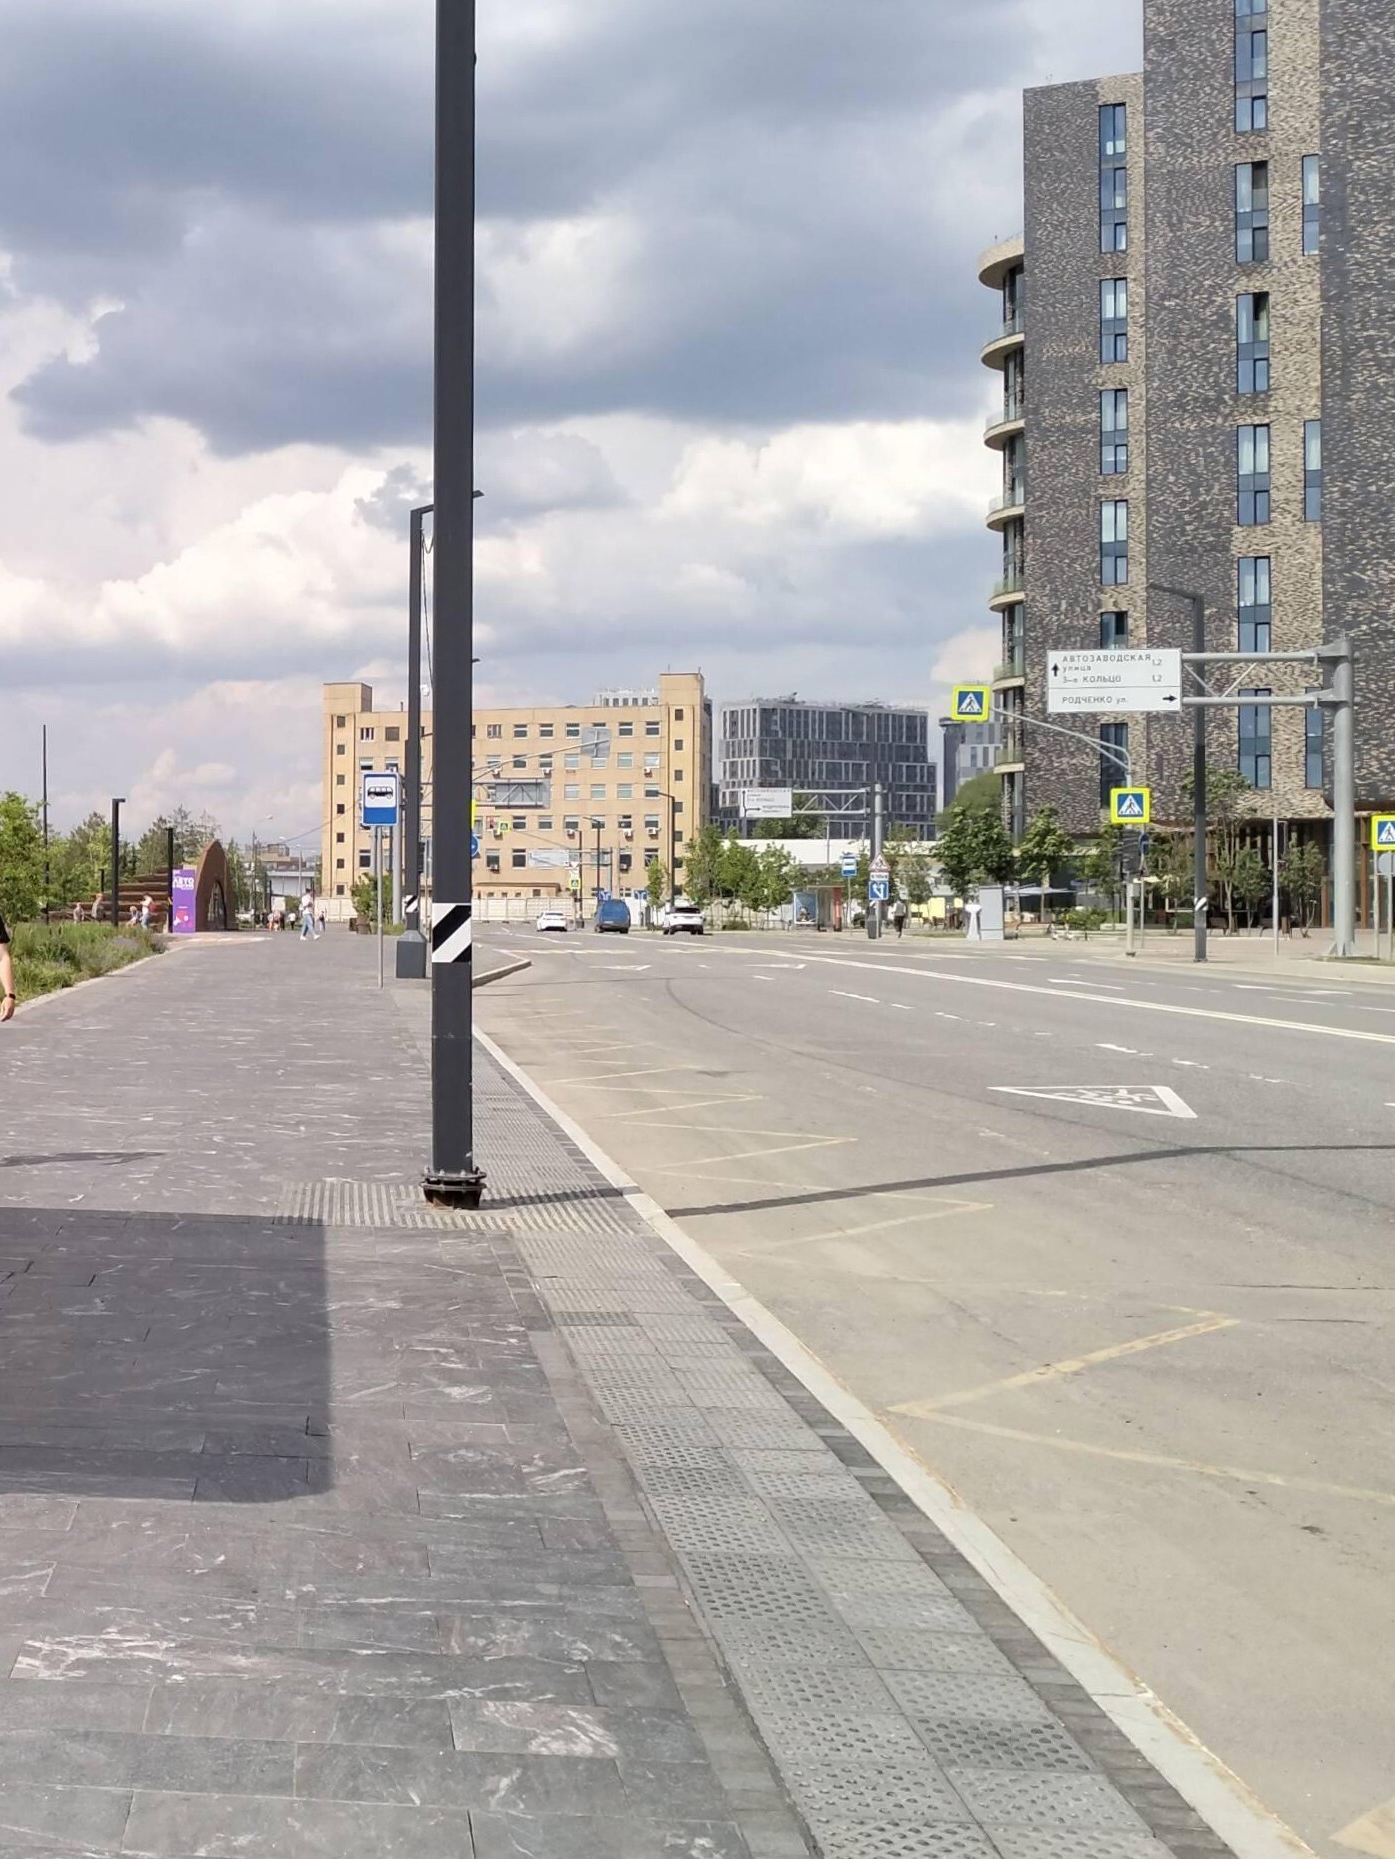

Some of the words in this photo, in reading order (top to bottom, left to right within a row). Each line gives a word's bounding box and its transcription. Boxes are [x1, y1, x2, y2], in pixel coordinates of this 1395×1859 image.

[1062, 654, 1151, 662] АВТОЗАВОДСКАЯ
[1063, 665, 1092, 673] улица
[1082, 675, 1122, 683] КОЛЬЦО
[1062, 696, 1113, 704] РОДЧЕНКО
